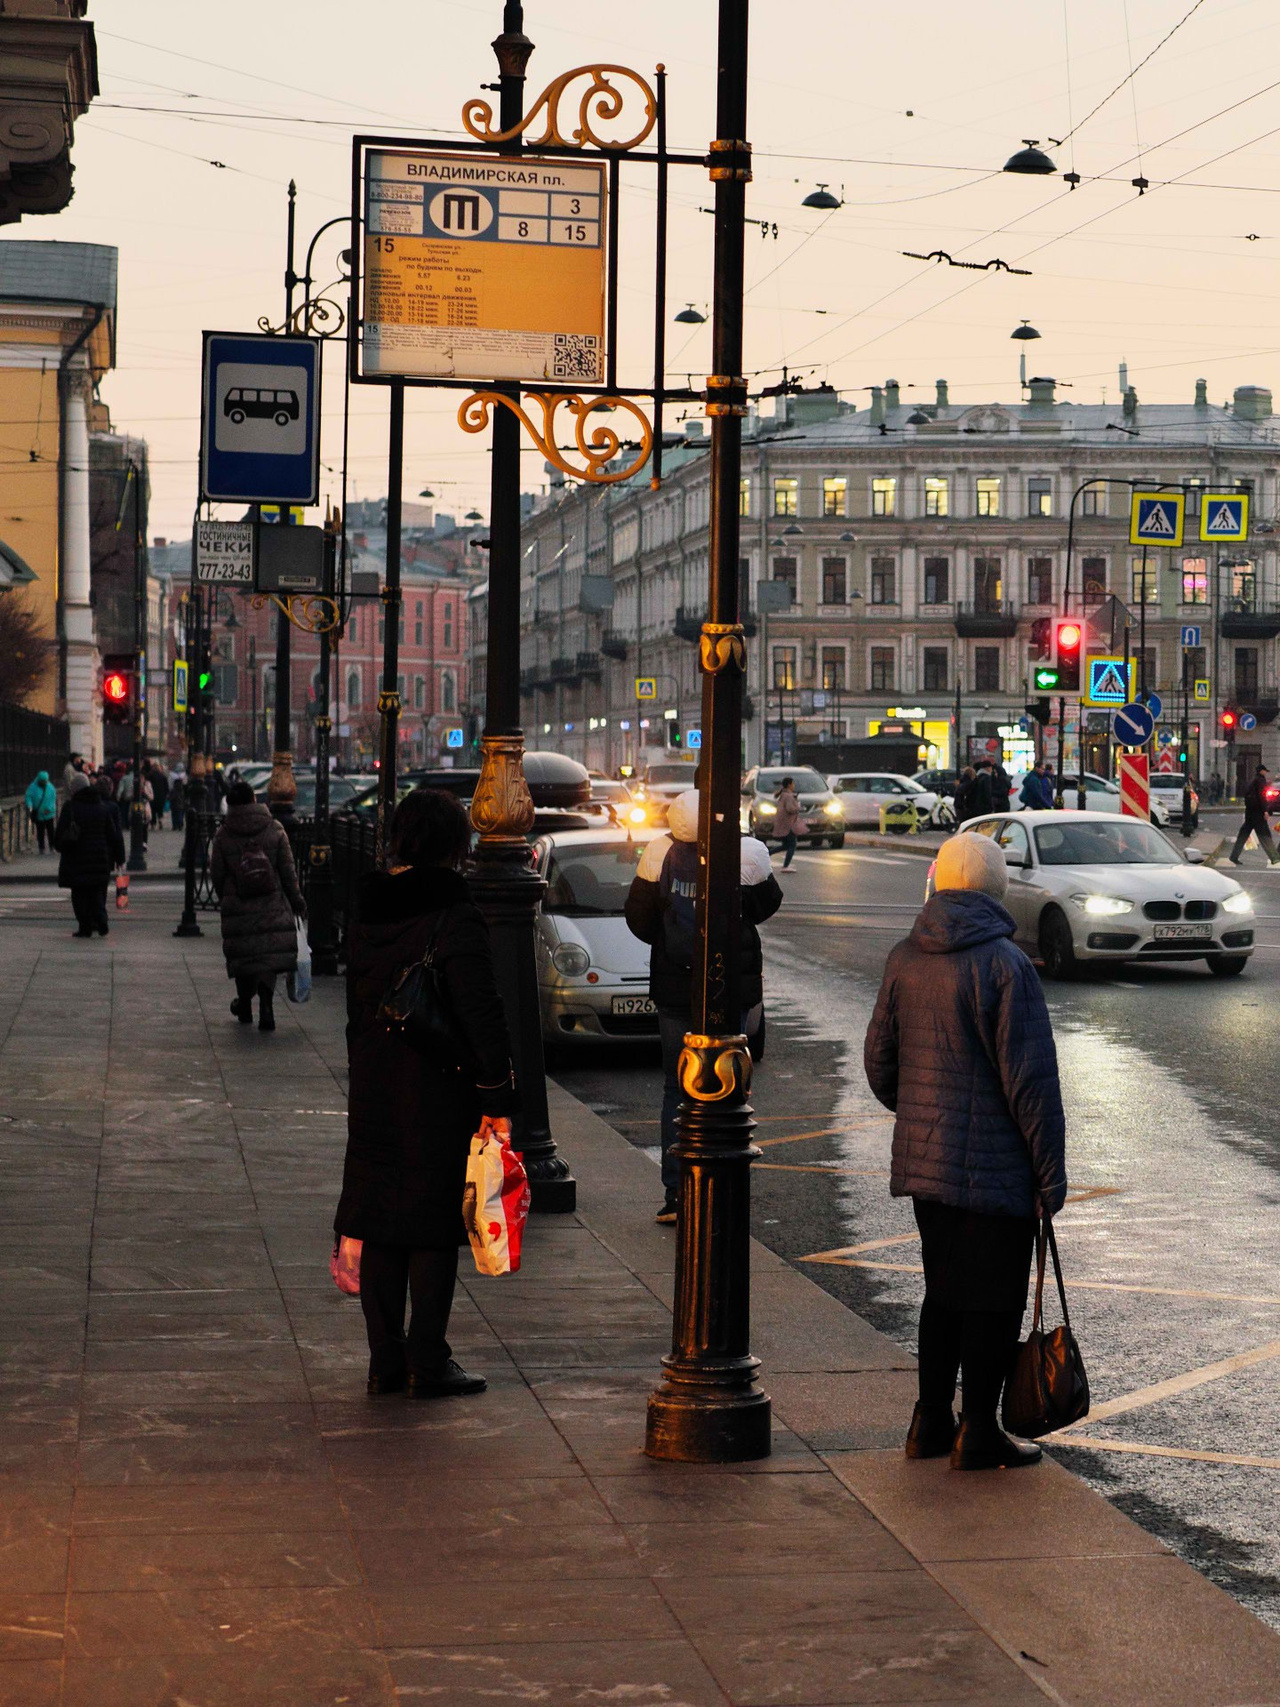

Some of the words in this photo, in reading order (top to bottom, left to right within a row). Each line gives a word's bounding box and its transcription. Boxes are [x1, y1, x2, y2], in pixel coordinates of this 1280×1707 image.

[407, 163, 538, 184] ВЛАДИМИРСКАЯ
[542, 175, 565, 186] пл.
[571, 199, 581, 214] 3
[518, 222, 529, 237] 8
[565, 225, 586, 241] 15
[373, 237, 395, 253] 15
[367, 325, 378, 333] 15
[200, 530, 251, 542] ГОСТИНИЧНЫЕ
[200, 541, 251, 553] ЧЕКИ
[200, 563, 251, 580] 777-23-43
[617, 999, 658, 1013] Н926
